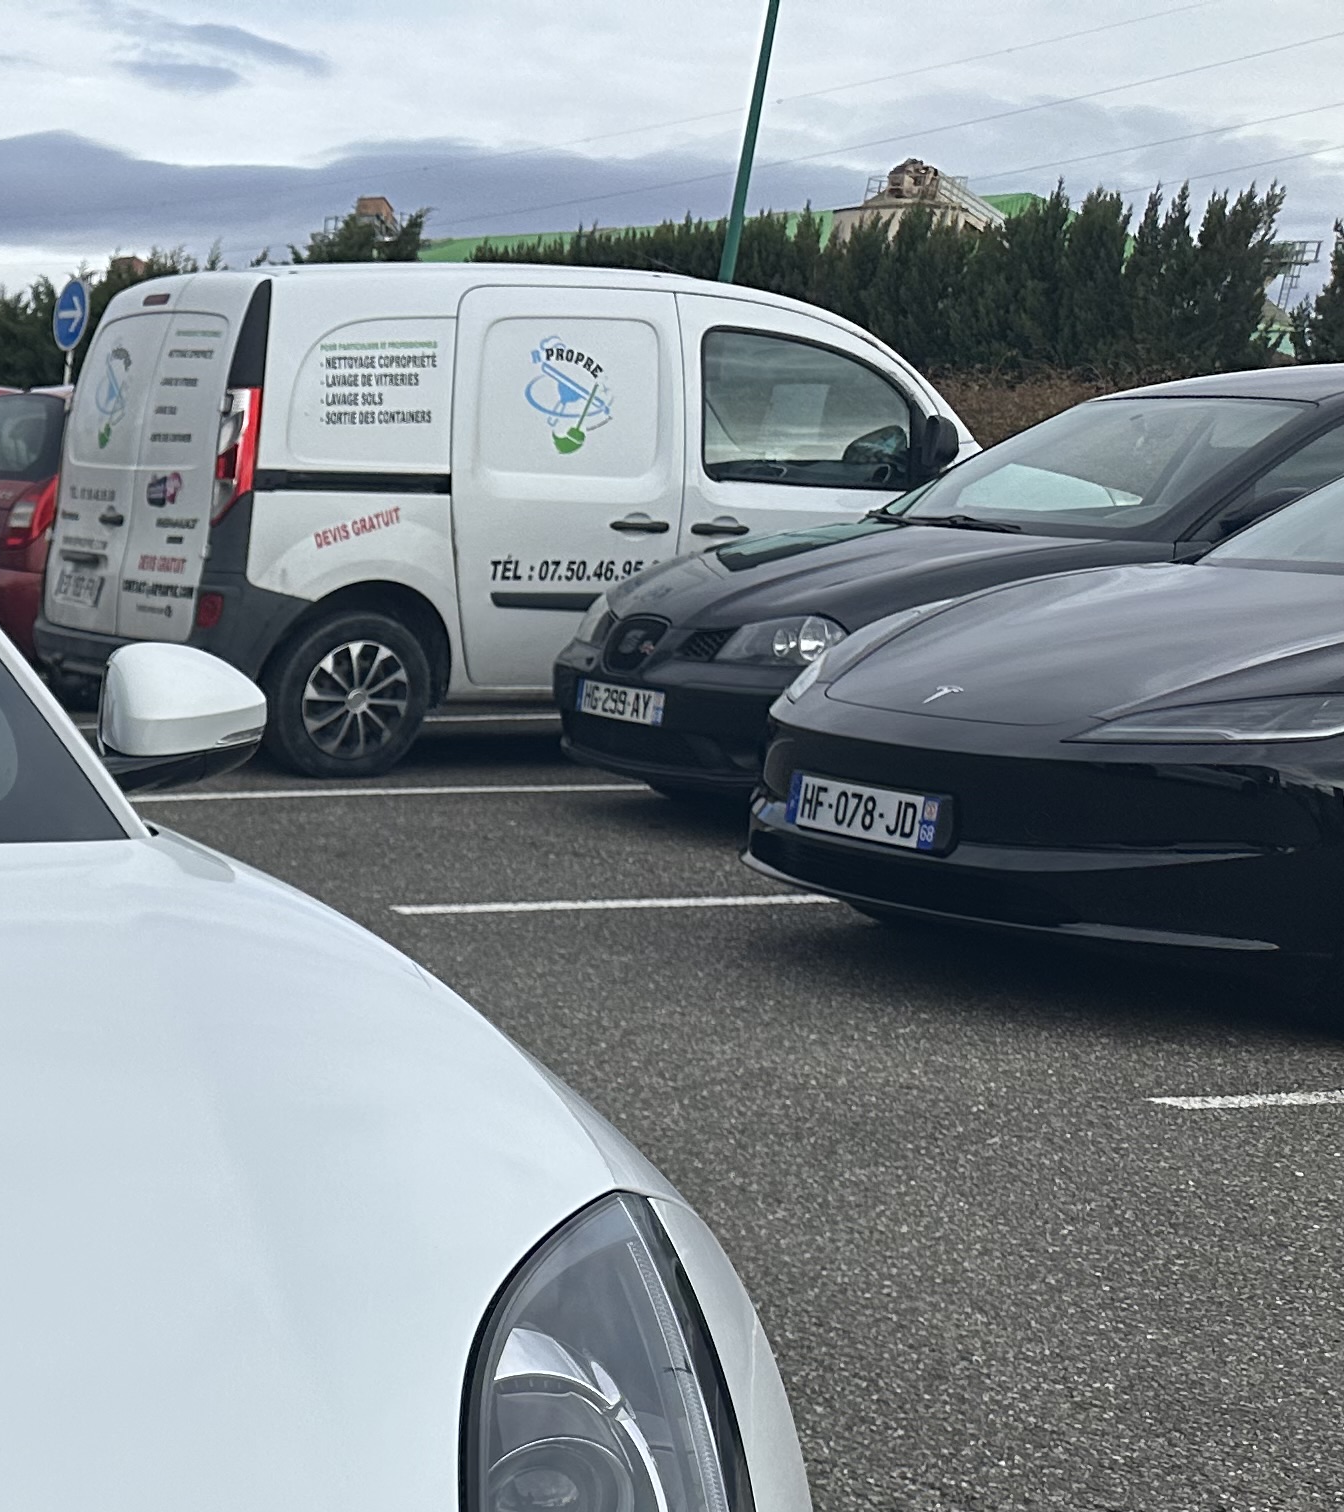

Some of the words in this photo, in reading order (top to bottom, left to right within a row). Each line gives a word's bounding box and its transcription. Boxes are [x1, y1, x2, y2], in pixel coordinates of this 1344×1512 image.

[325, 355, 376, 369] NETTOYAGE
[545, 348, 603, 379] PROPRE
[325, 373, 359, 387] LAVAGE
[361, 373, 373, 386] DE
[374, 372, 419, 386] VITRERIES
[325, 392, 359, 406] LAVAGE
[361, 391, 383, 406] SOLS
[325, 411, 357, 425] SORTIE
[359, 410, 375, 424] DES
[377, 409, 431, 423] CONTAINERS
[314, 523, 349, 549] DEVIS
[351, 507, 401, 536] GRATUIT
[490, 554, 522, 581] TÉL
[584, 683, 652, 720] HG-299-AY
[800, 783, 918, 839] HF-078-JD
[920, 824, 935, 843] 68
